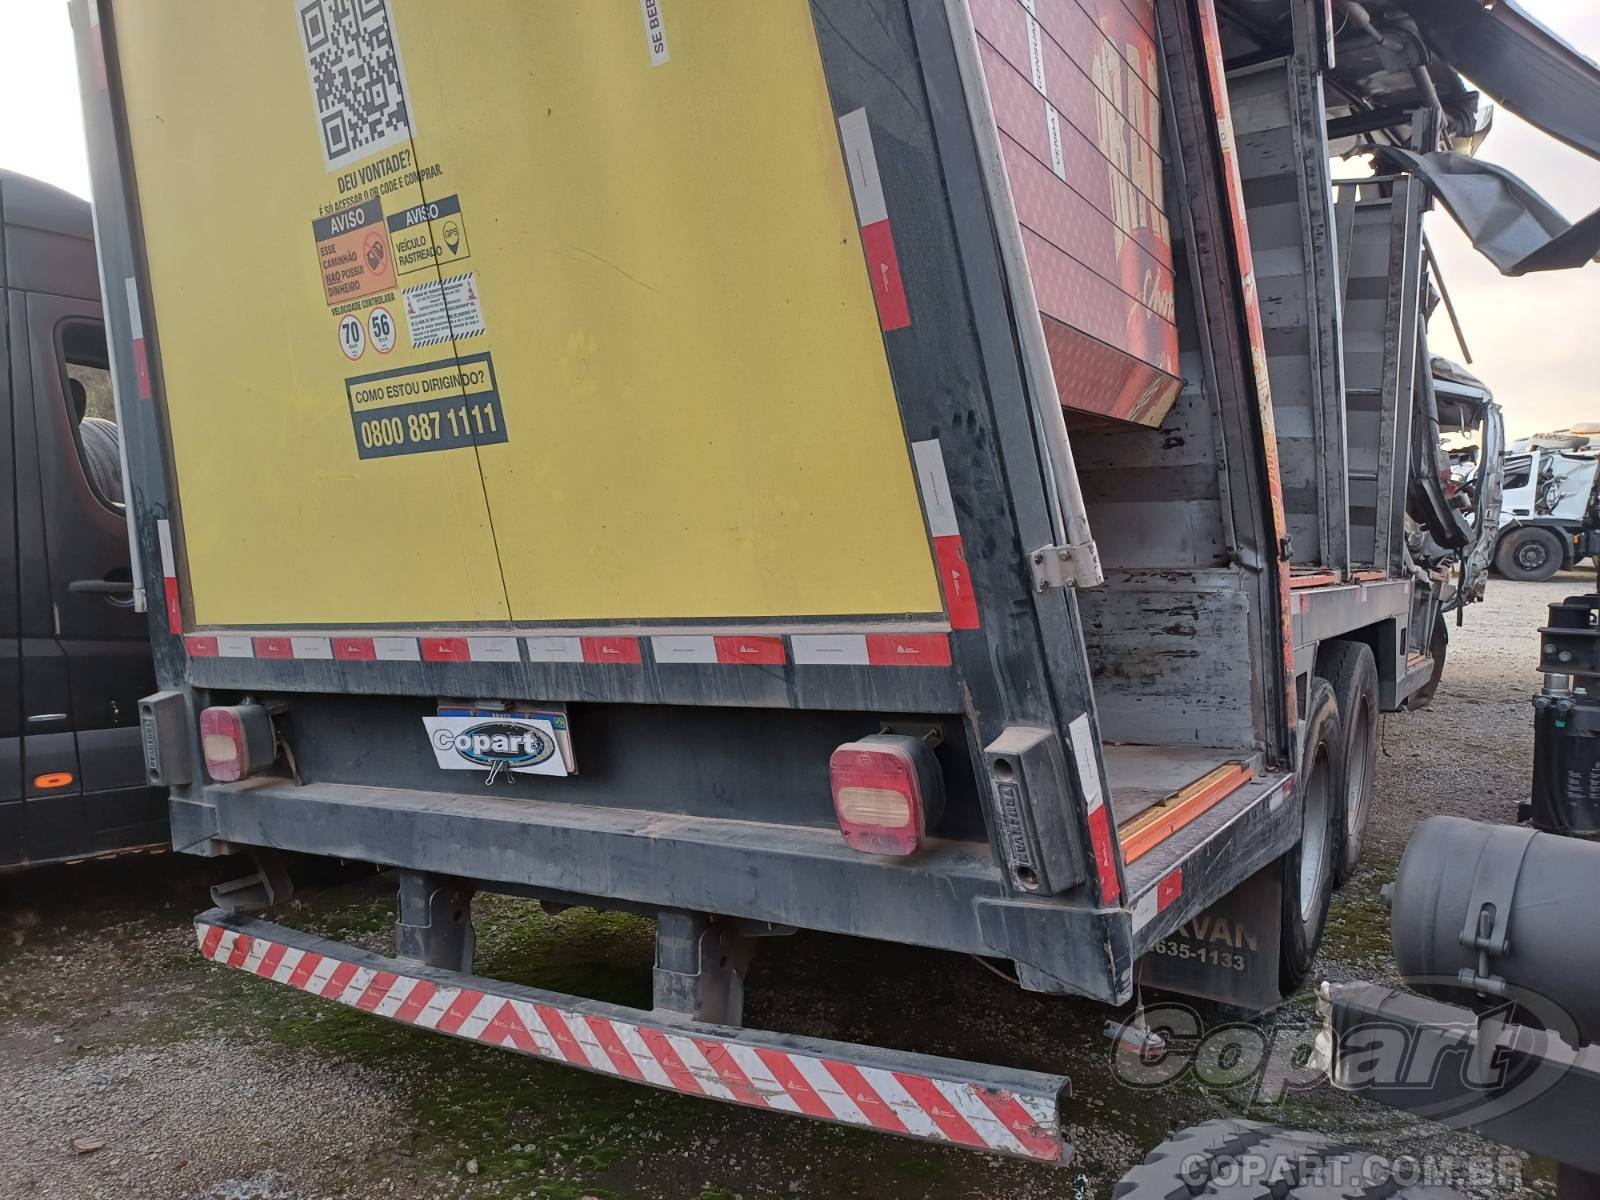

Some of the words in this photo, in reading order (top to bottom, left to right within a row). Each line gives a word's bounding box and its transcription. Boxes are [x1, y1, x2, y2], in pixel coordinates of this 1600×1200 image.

[651, 31, 664, 54] SE
[337, 171, 358, 194] DEU
[358, 149, 412, 185] VONTADE?
[380, 180, 398, 196] CODE
[398, 177, 405, 189] E
[404, 163, 444, 187] COMPRAR.
[331, 207, 365, 235] AVISO
[406, 203, 439, 227] AVISO
[395, 235, 427, 253] VEÍCULO
[444, 226, 459, 239] GPS
[320, 243, 337, 257] ESSE
[398, 245, 443, 267] RASTREADO
[327, 280, 361, 297] DINHEIRO
[331, 301, 362, 317] VELOCIDADE
[361, 292, 396, 311] CONTROLADA
[342, 321, 360, 345] 70
[371, 313, 390, 338] 56
[355, 387, 385, 404] COMO
[386, 381, 420, 399] ESTOU
[422, 369, 485, 394] DIRIGINDO?
[361, 416, 405, 449] 0800
[407, 411, 441, 443] 887
[447, 402, 497, 437] 1111
[432, 727, 537, 756] Copart
[1150, 940, 1245, 971] 635-1133
